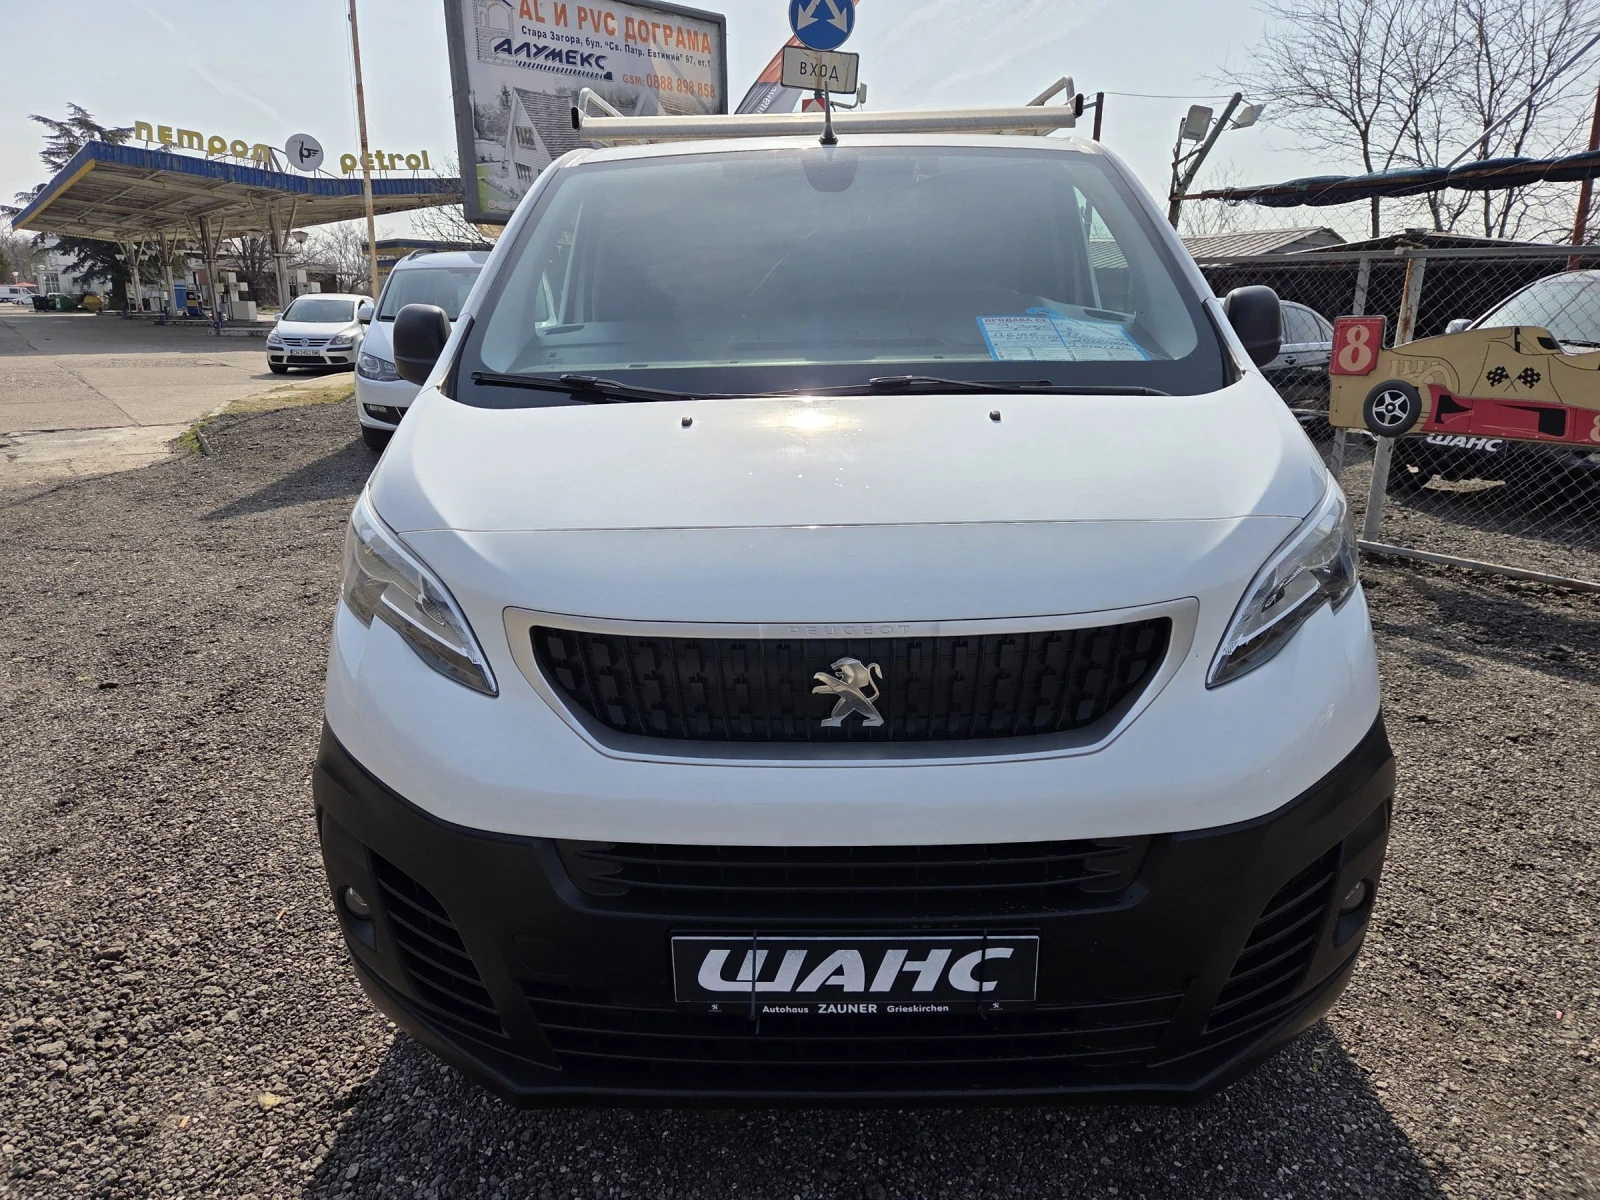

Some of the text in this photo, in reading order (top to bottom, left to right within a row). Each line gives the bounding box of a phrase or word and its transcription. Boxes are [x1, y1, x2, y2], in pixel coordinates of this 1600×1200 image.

[519, 0, 711, 54] AL И PVC ДОГРАМА
[521, 25, 547, 39] Стара
[550, 31, 583, 46] Загора,
[585, 37, 603, 49] бул.
[624, 44, 645, 57] Патр.
[494, 38, 608, 70] АЛУМЕКС
[800, 61, 839, 81] ВХОД
[622, 74, 715, 98] GSM: 0888 898 858
[1338, 325, 1372, 372] 8
[1426, 433, 1502, 452] ШАНС
[788, 624, 911, 636] PEUGEOT
[698, 948, 1014, 992] ШАНС
[762, 1003, 949, 1014] Autohaus ZAUNER Grieskirchen
